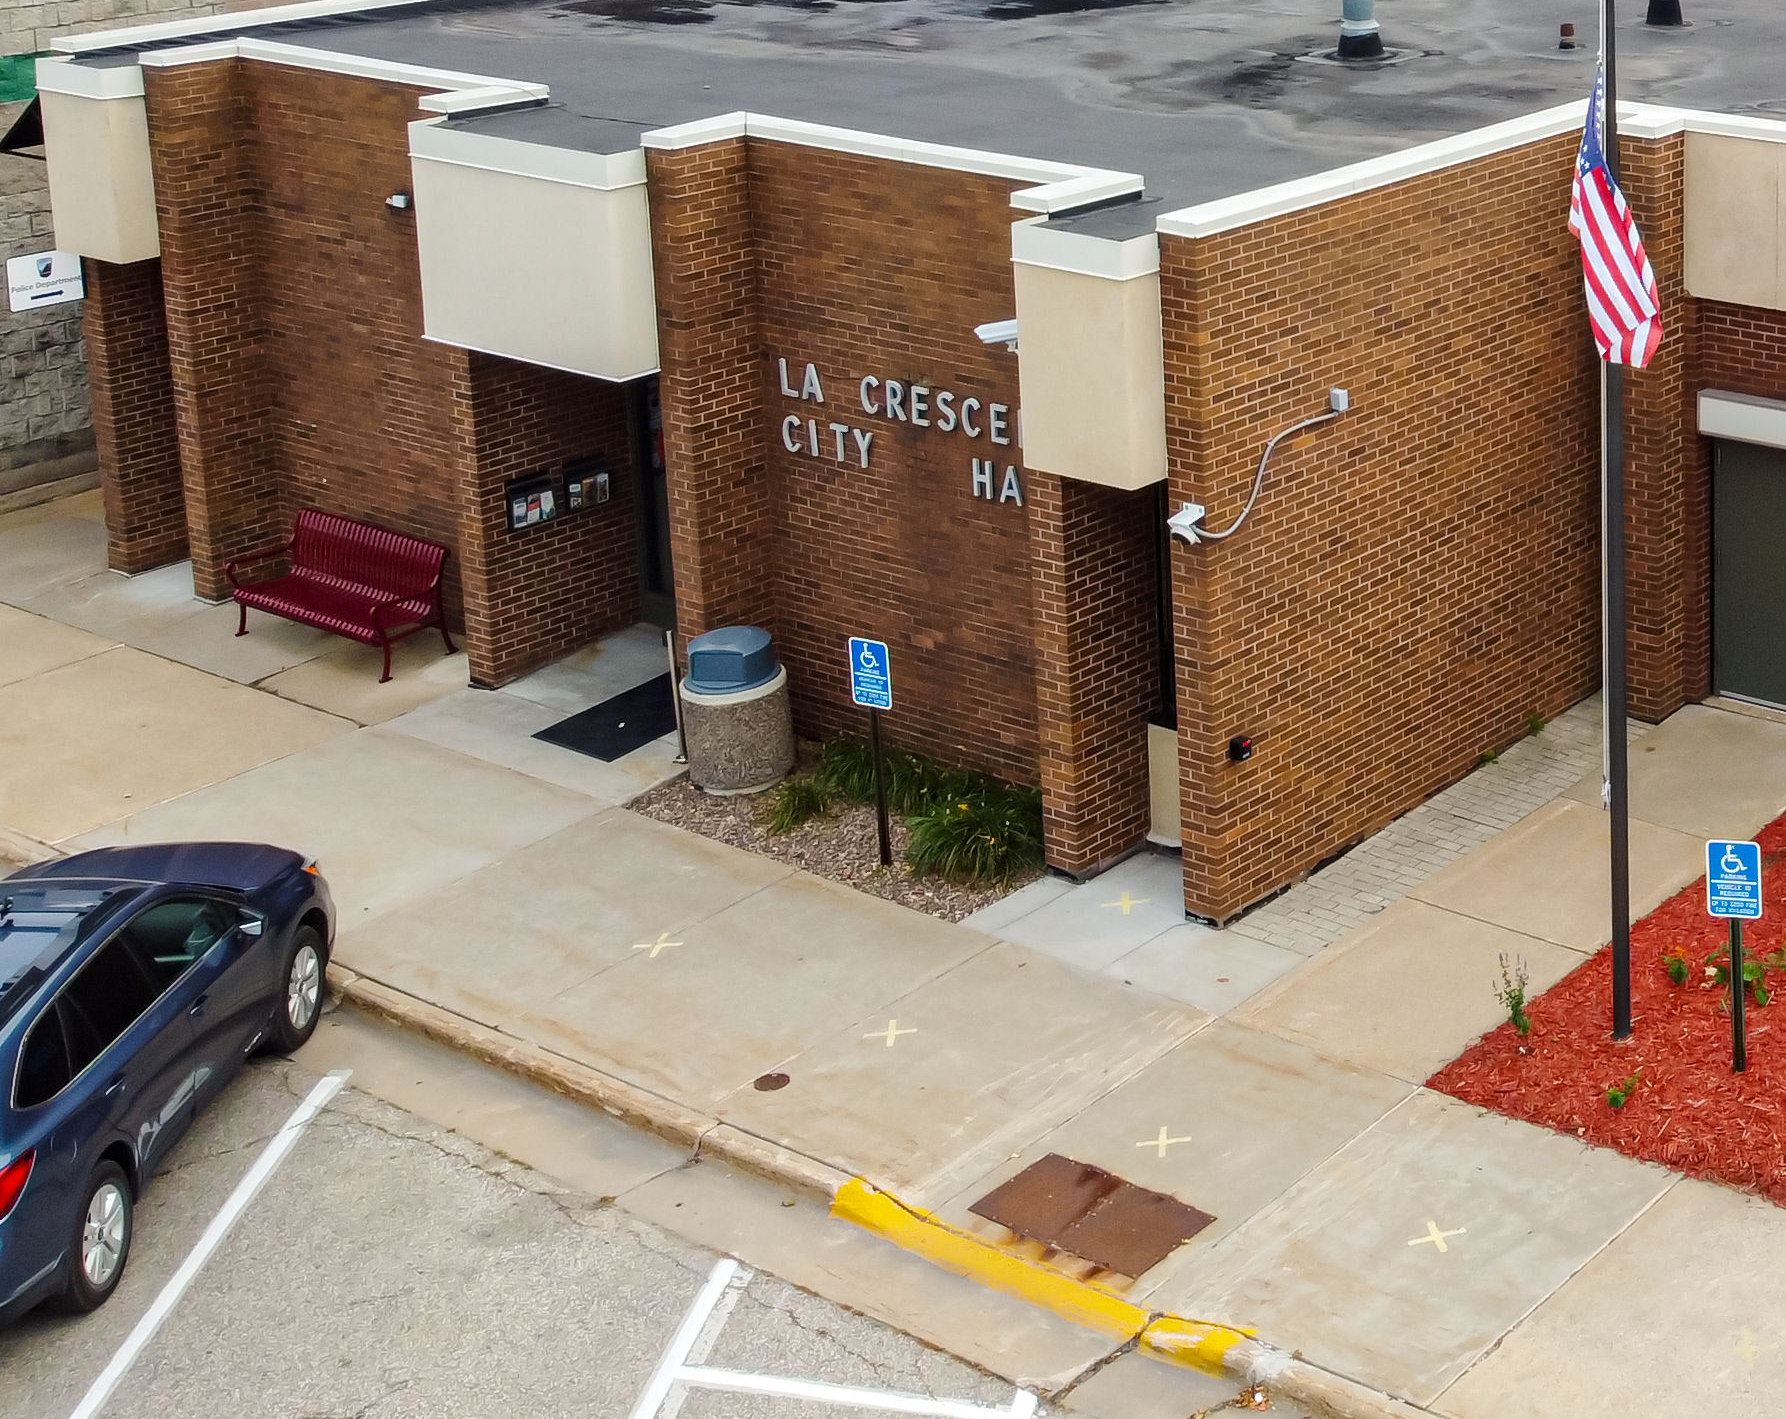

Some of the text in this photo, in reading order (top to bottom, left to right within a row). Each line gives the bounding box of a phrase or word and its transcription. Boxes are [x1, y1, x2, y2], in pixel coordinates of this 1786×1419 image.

[11, 274, 82, 294] Police Department
[778, 357, 1023, 449] LA CRESCE
[782, 414, 1023, 507] CITY HA
